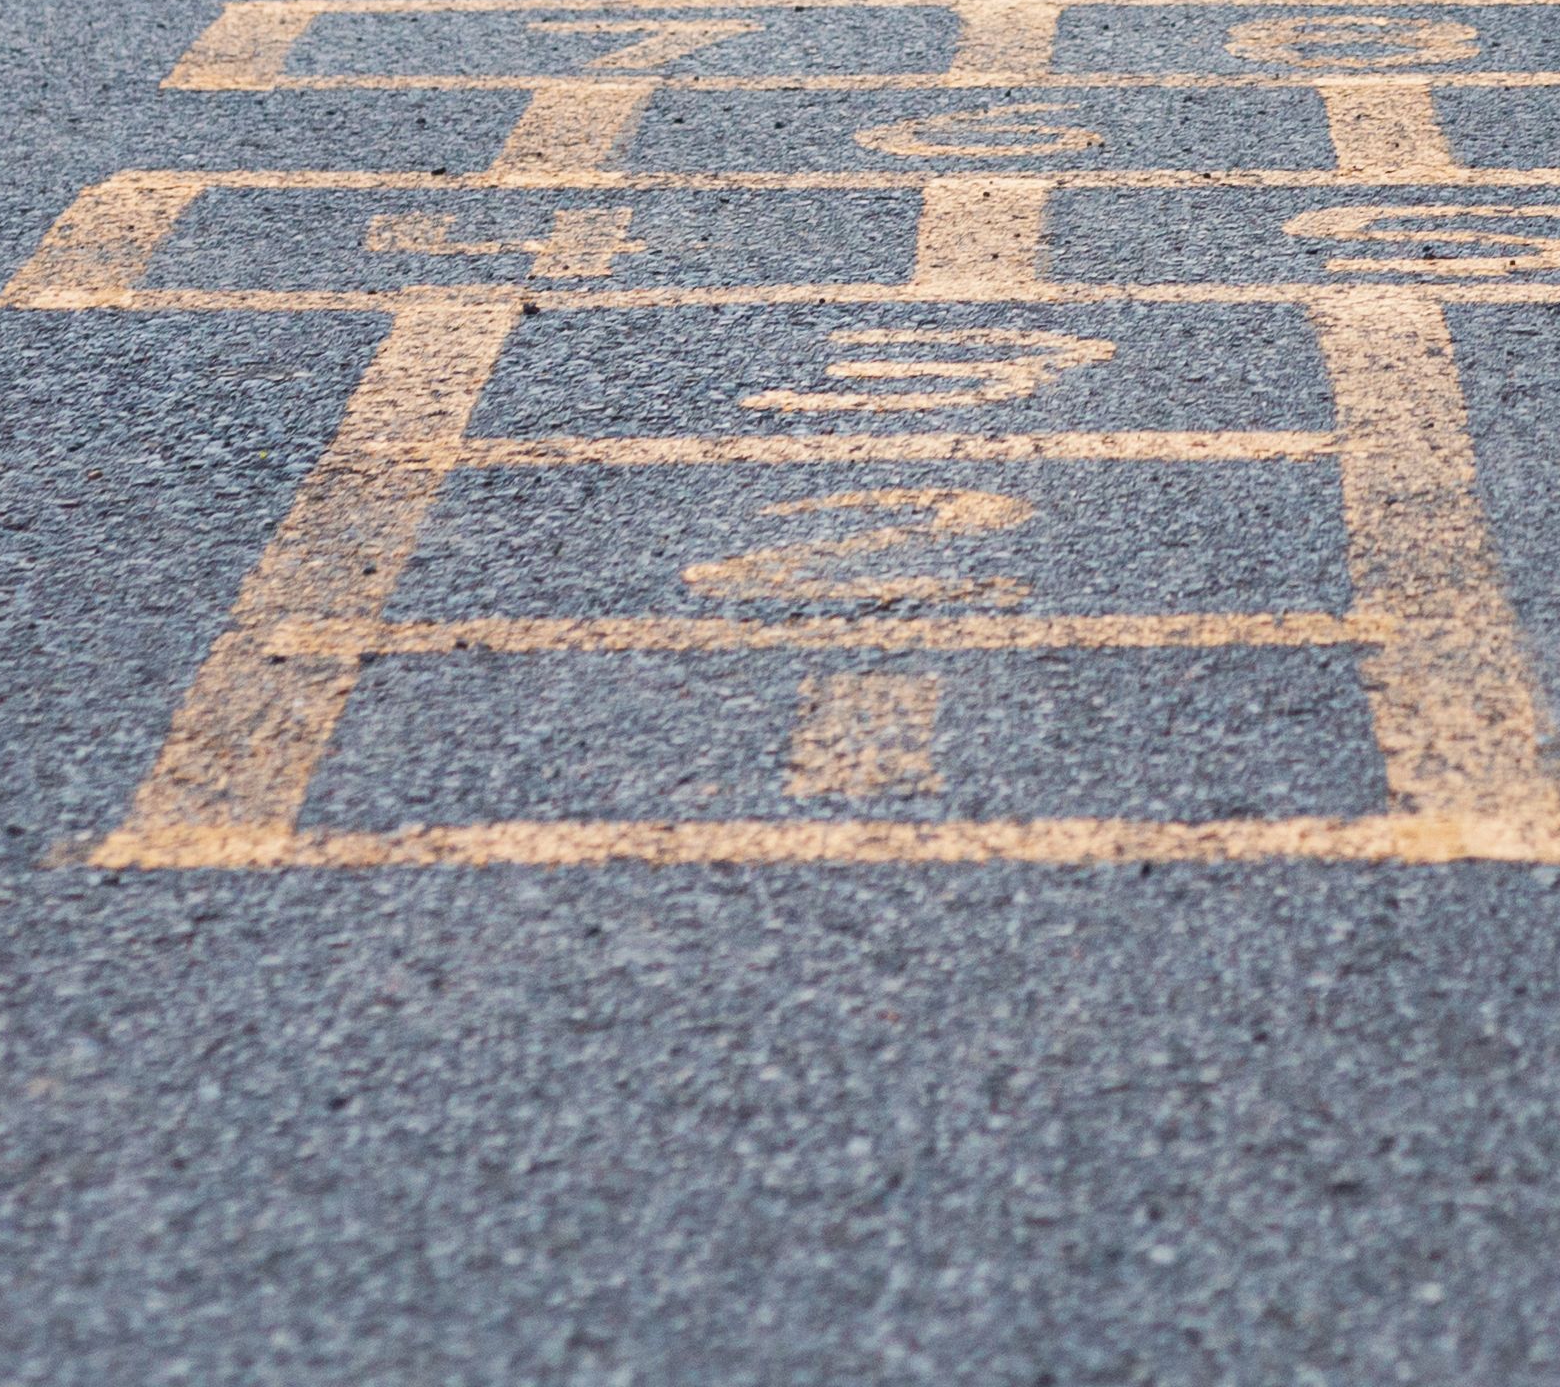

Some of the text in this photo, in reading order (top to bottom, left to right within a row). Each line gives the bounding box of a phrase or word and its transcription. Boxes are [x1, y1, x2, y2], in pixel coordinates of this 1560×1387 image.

[529, 18, 762, 70] 7
[1224, 14, 1481, 69] 8
[853, 102, 1106, 157] 6
[364, 207, 646, 279] 4
[740, 328, 1117, 413] 3
[681, 488, 1038, 608] 2
[783, 672, 944, 798] 1
